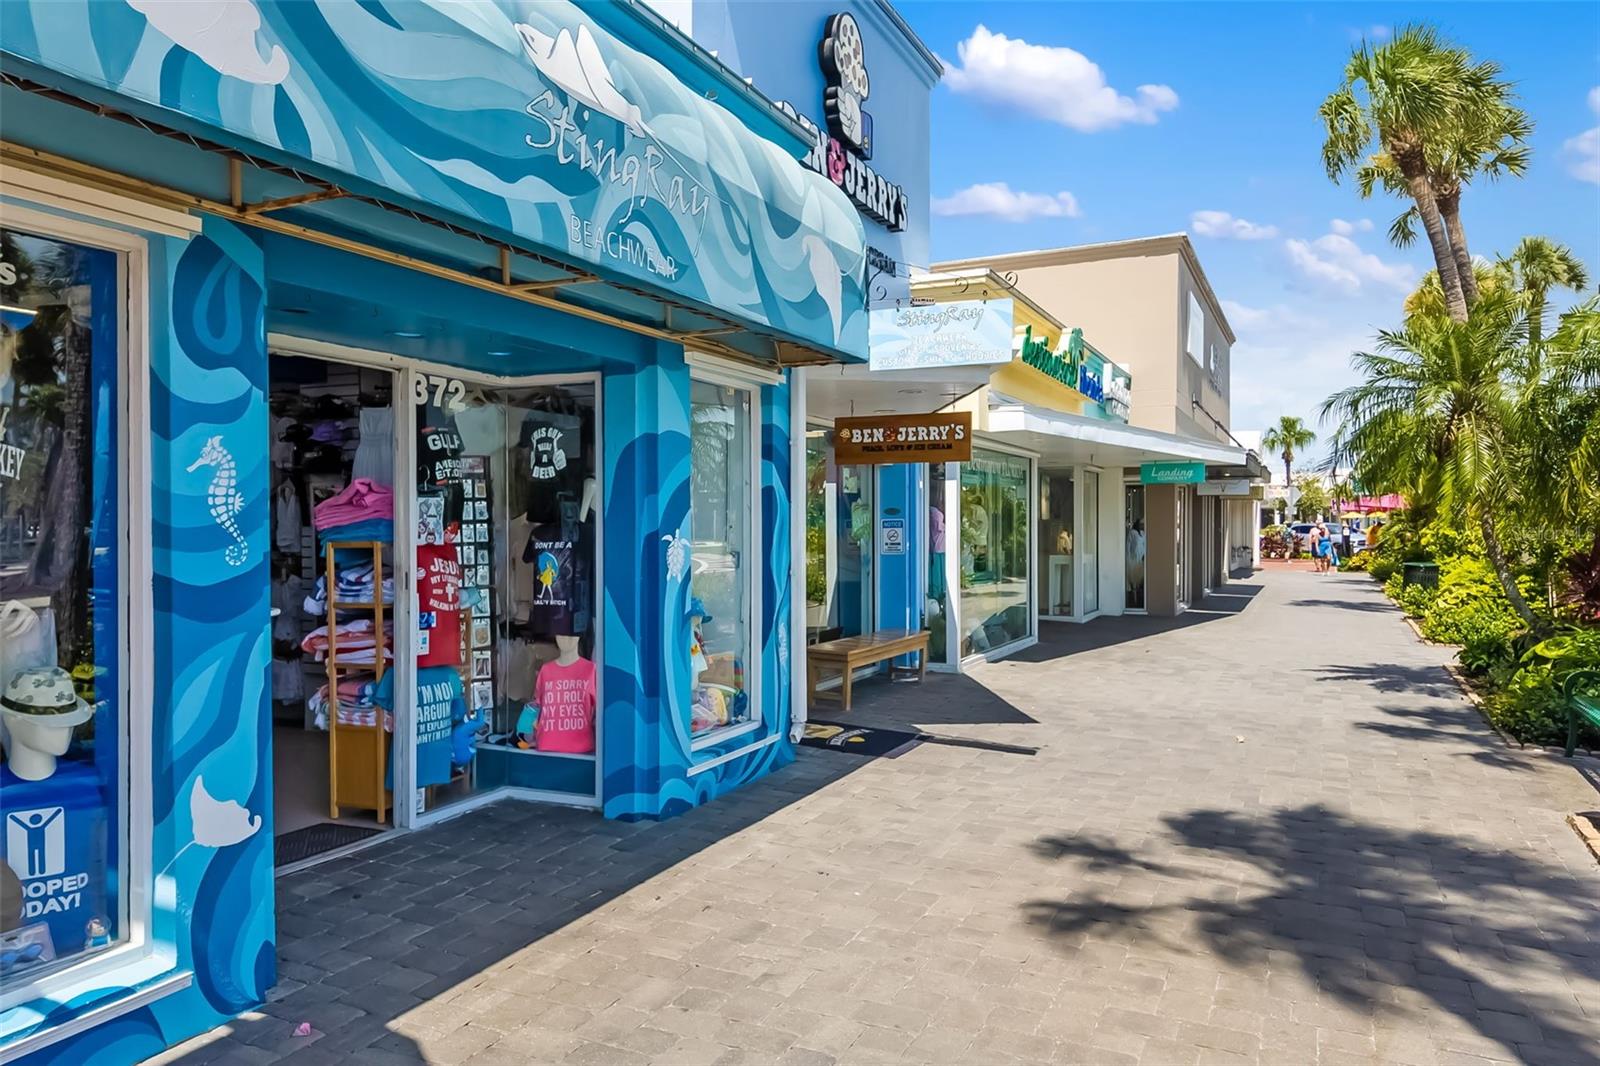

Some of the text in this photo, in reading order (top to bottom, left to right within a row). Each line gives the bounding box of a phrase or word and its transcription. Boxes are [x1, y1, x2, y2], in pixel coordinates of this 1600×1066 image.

[525, 89, 711, 258] StingRay
[844, 149, 909, 234] JERRY'S
[570, 214, 681, 281] BEACHWEAR
[896, 305, 985, 334] StingRay
[415, 374, 467, 415] 372
[852, 428, 884, 443] BEN
[897, 423, 965, 441] JERRY'S
[532, 465, 556, 479] BEER
[1151, 467, 1194, 479] Landing
[554, 541, 566, 549] BE
[566, 541, 573, 549] A
[556, 679, 589, 690] SORRY
[417, 701, 451, 723] ARGUIN
[560, 704, 584, 717] EYES
[22, 872, 89, 899] OPED
[20, 892, 81, 920] DAY!
